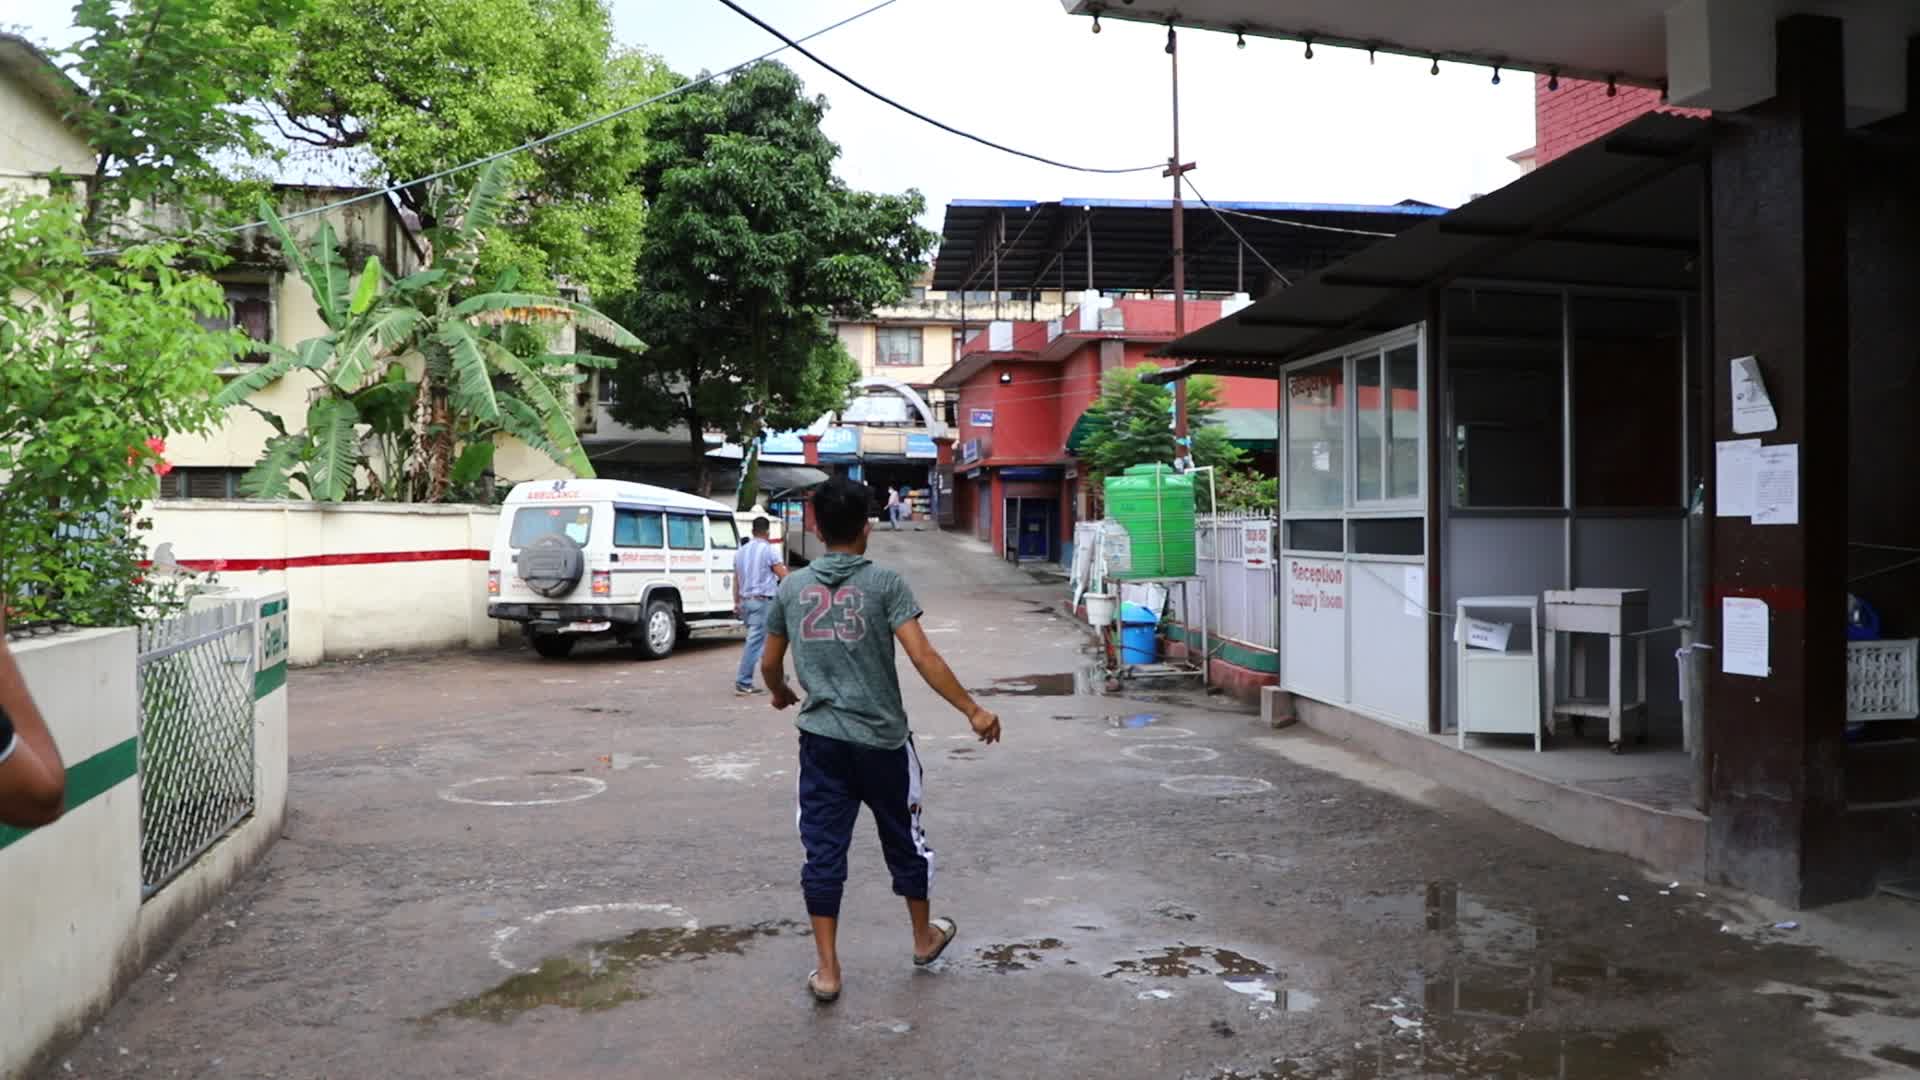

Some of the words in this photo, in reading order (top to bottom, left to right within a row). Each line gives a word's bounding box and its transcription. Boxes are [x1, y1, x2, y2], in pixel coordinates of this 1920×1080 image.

[1292, 561, 1343, 588] Reception
[1320, 590, 1344, 608] Room
[799, 584, 867, 642] 23
